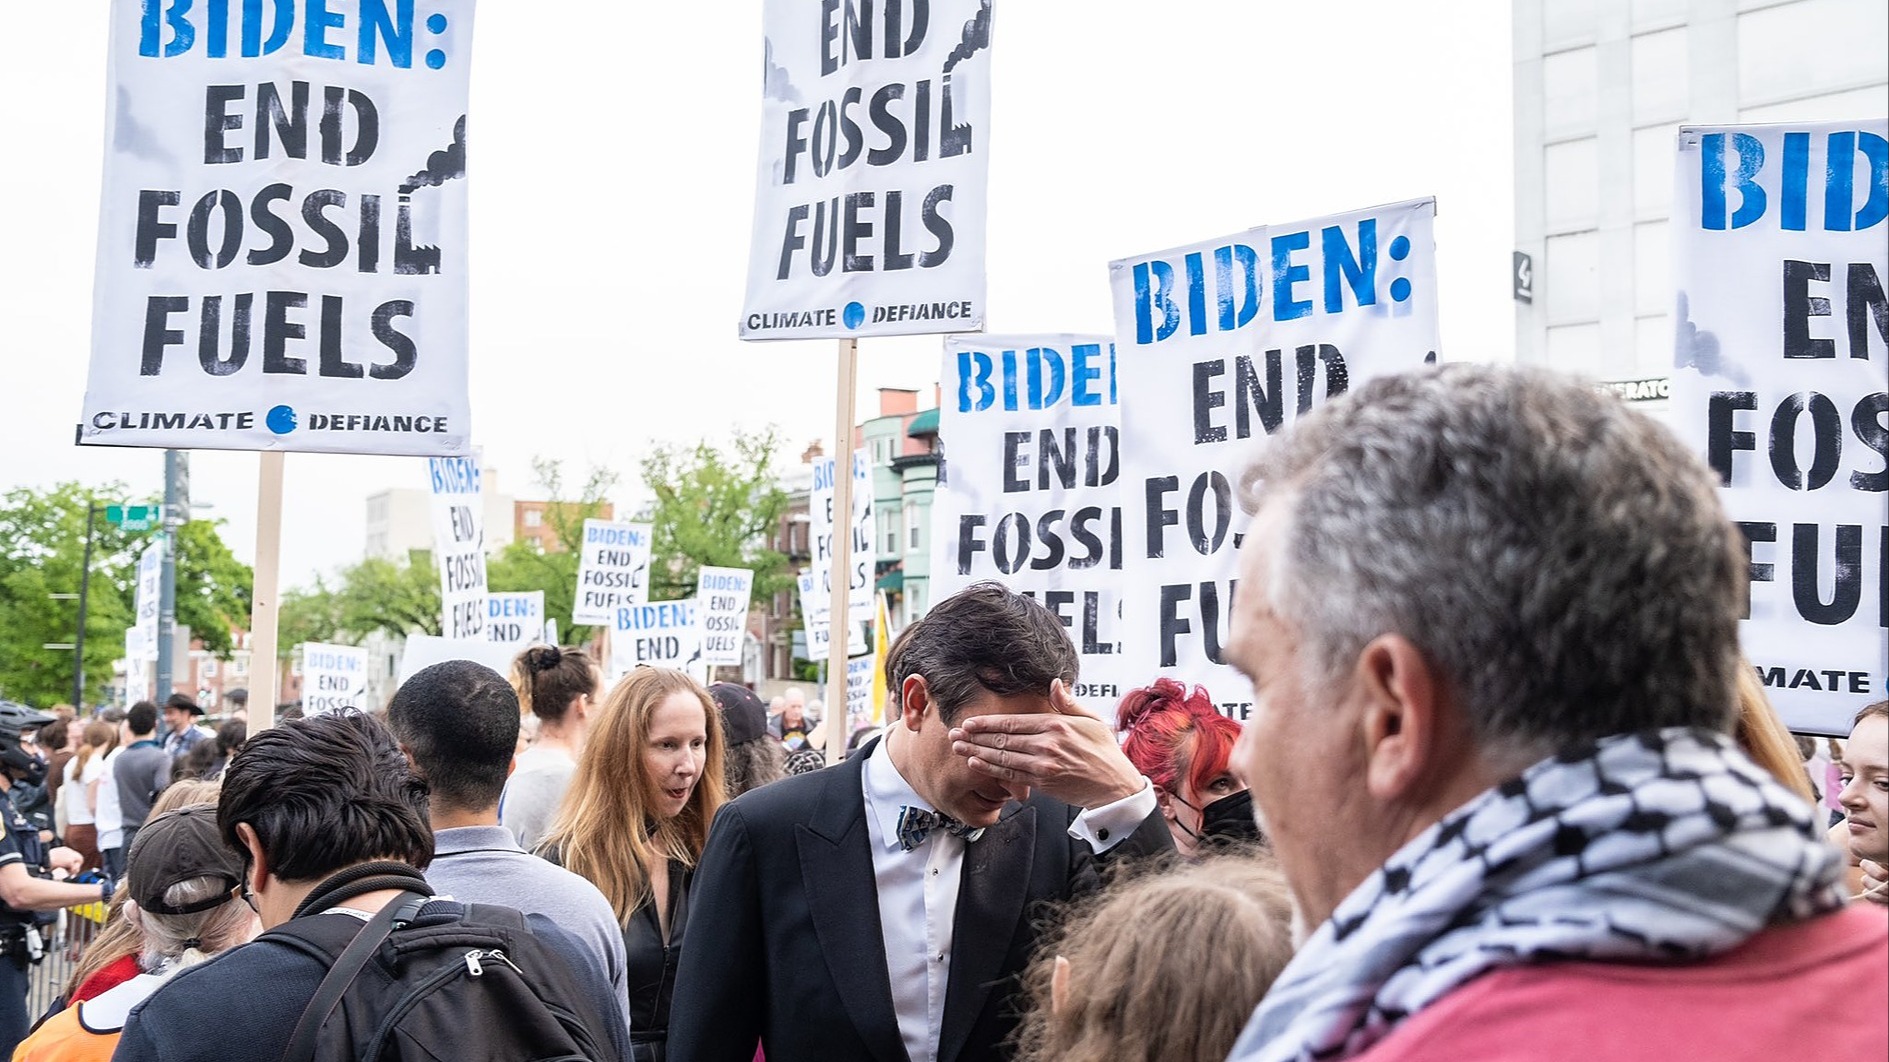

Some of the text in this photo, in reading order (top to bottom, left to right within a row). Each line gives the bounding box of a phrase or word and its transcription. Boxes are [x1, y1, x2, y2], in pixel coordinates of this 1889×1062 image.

[138, 0, 447, 69] BIDEN:
[821, 0, 929, 77] END
[204, 81, 379, 166] END
[783, 74, 972, 185] FOSSIL
[133, 183, 441, 275] FOSSIL
[776, 184, 954, 280] FUELS
[1132, 218, 1412, 344] BIDEN:
[140, 291, 417, 380] FUELS
[747, 301, 971, 330] CLIMATE DEFIANCE
[92, 411, 447, 433] CLIMATE DEFIANCE
[1192, 344, 1349, 446] END
[1003, 426, 1119, 493] END
[588, 527, 645, 546] BIDEN:
[598, 550, 630, 566] END
[584, 570, 639, 588] FOSSIL
[711, 596, 736, 610] END
[618, 604, 694, 630] BIDEN:
[636, 636, 679, 660] END
[319, 675, 349, 691] END
